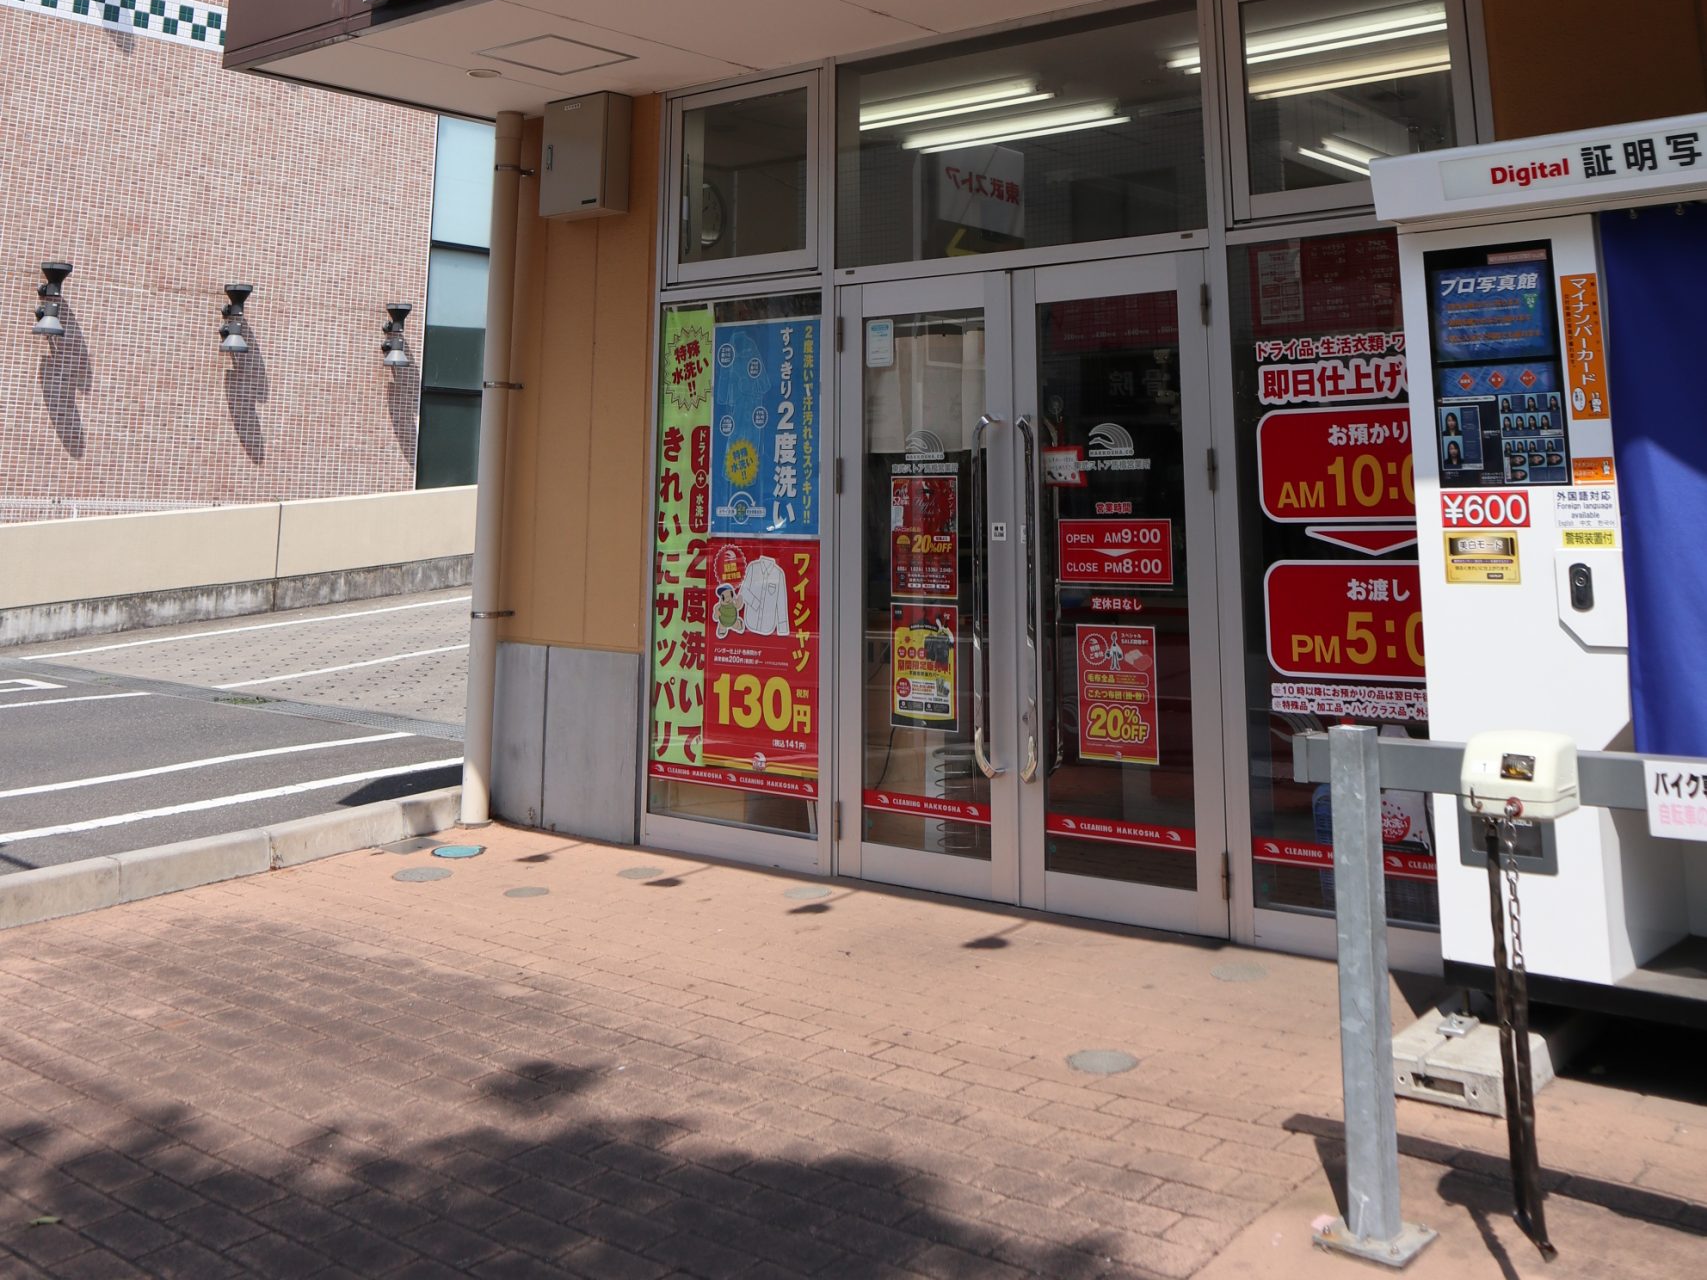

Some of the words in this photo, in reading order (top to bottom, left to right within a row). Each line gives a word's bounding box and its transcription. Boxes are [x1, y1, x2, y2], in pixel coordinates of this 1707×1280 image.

[1490, 158, 1570, 186] Digital
[1580, 132, 1703, 179] 証明写
[1441, 272, 1538, 297] プロ写真館
[1569, 277, 1596, 386] マイナンバーカード
[1262, 361, 1409, 400] 即日仕上げ
[1328, 420, 1411, 446] お預かり
[1443, 494, 1527, 525] ¥600
[1557, 502, 1581, 510] Foreign
[1583, 502, 1612, 510] language
[1066, 533, 1094, 544] OPEN
[1104, 528, 1161, 544] AM9:00
[1066, 562, 1099, 573] CLOSE
[1104, 559, 1162, 574] PM8:00
[1346, 578, 1410, 602] お渡し
[792, 553, 811, 673] ワイシャツ
[1091, 597, 1142, 611] 定休日なし
[1273, 699, 1429, 719] ※特殊品・加工品・ハイクラス品・外
[1284, 847, 1323, 859] CLEANING
